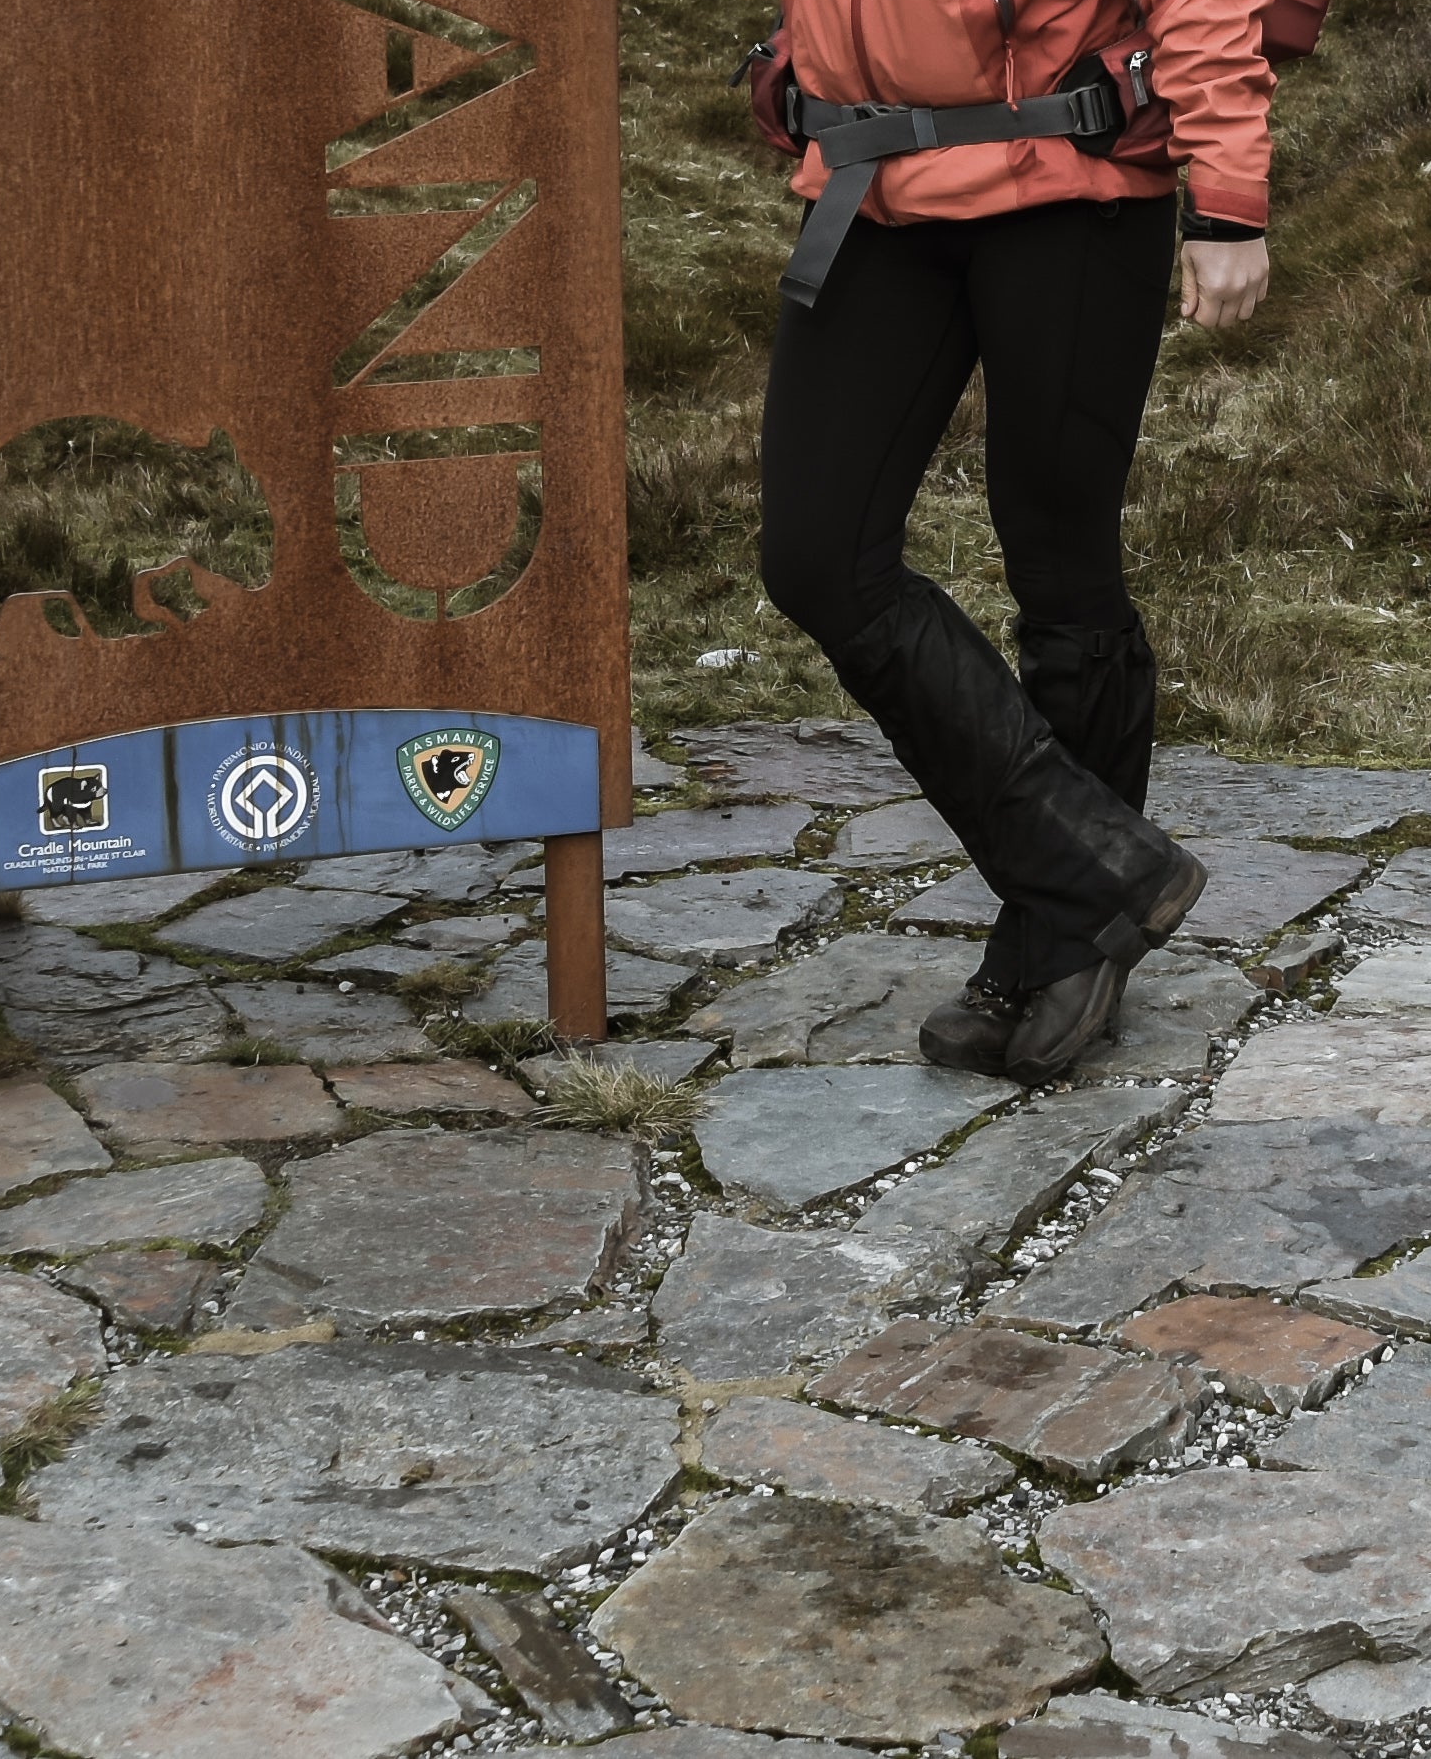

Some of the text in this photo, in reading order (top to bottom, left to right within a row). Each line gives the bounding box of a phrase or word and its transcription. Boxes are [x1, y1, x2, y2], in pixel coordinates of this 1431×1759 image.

[401, 732, 494, 757] TASMANIA
[212, 741, 268, 781] PATRIMONIO
[403, 758, 495, 826] PARKS & WILDLIFE SERVICE
[18, 835, 132, 857] Cradle Mountain
